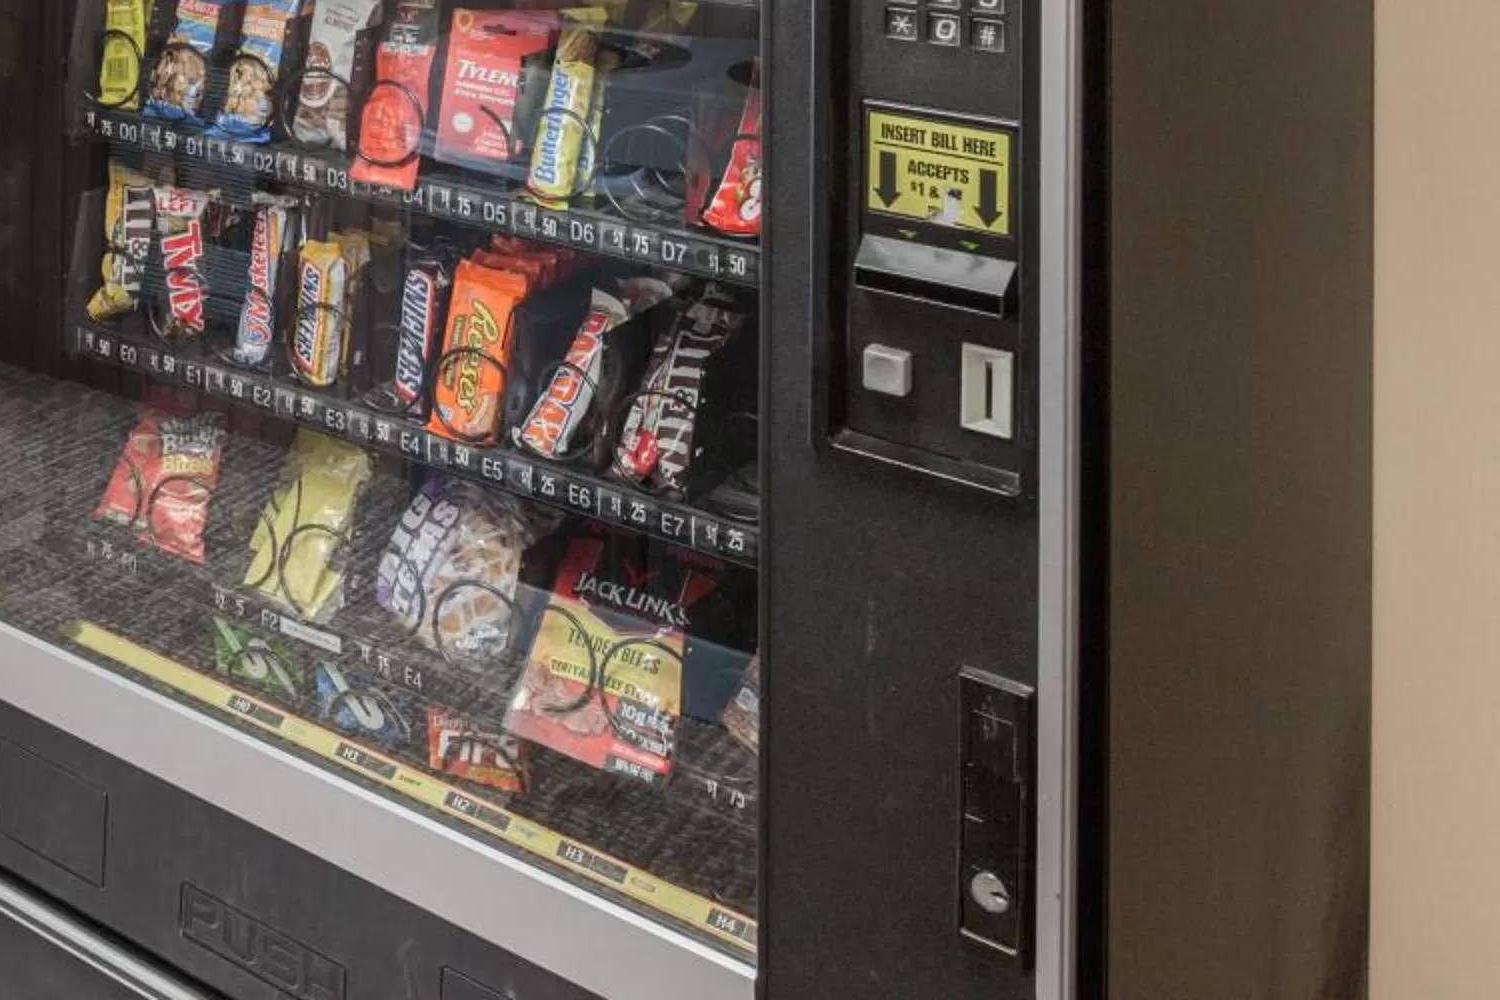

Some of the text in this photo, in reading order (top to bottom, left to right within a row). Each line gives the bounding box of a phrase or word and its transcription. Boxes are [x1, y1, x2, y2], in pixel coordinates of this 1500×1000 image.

[936, 20, 955, 39] 0
[119, 122, 138, 142] D0
[881, 123, 996, 158] INSERT BILL HERE
[186, 137, 203, 156] D1
[255, 152, 274, 173] D2
[907, 159, 969, 185] ACCEPTS
[327, 168, 348, 188] D3
[911, 181, 925, 197] $1
[483, 200, 507, 224] D5
[570, 220, 595, 243] D6
[661, 239, 689, 264] D7
[396, 268, 429, 389] SNICKERS
[120, 344, 138, 364] E0
[186, 364, 202, 384] E1
[253, 386, 272, 407] E2
[325, 406, 345, 427] E3
[400, 432, 421, 454] E4
[481, 457, 504, 480] E5
[568, 483, 592, 508] E6
[661, 513, 685, 537] E7
[573, 570, 627, 607] JACK
[261, 608, 279, 631] F2
[404, 666, 422, 689] F4
[342, 746, 359, 762] H1
[451, 796, 470, 811] H2
[564, 846, 586, 863] H3
[716, 915, 737, 931] H4
